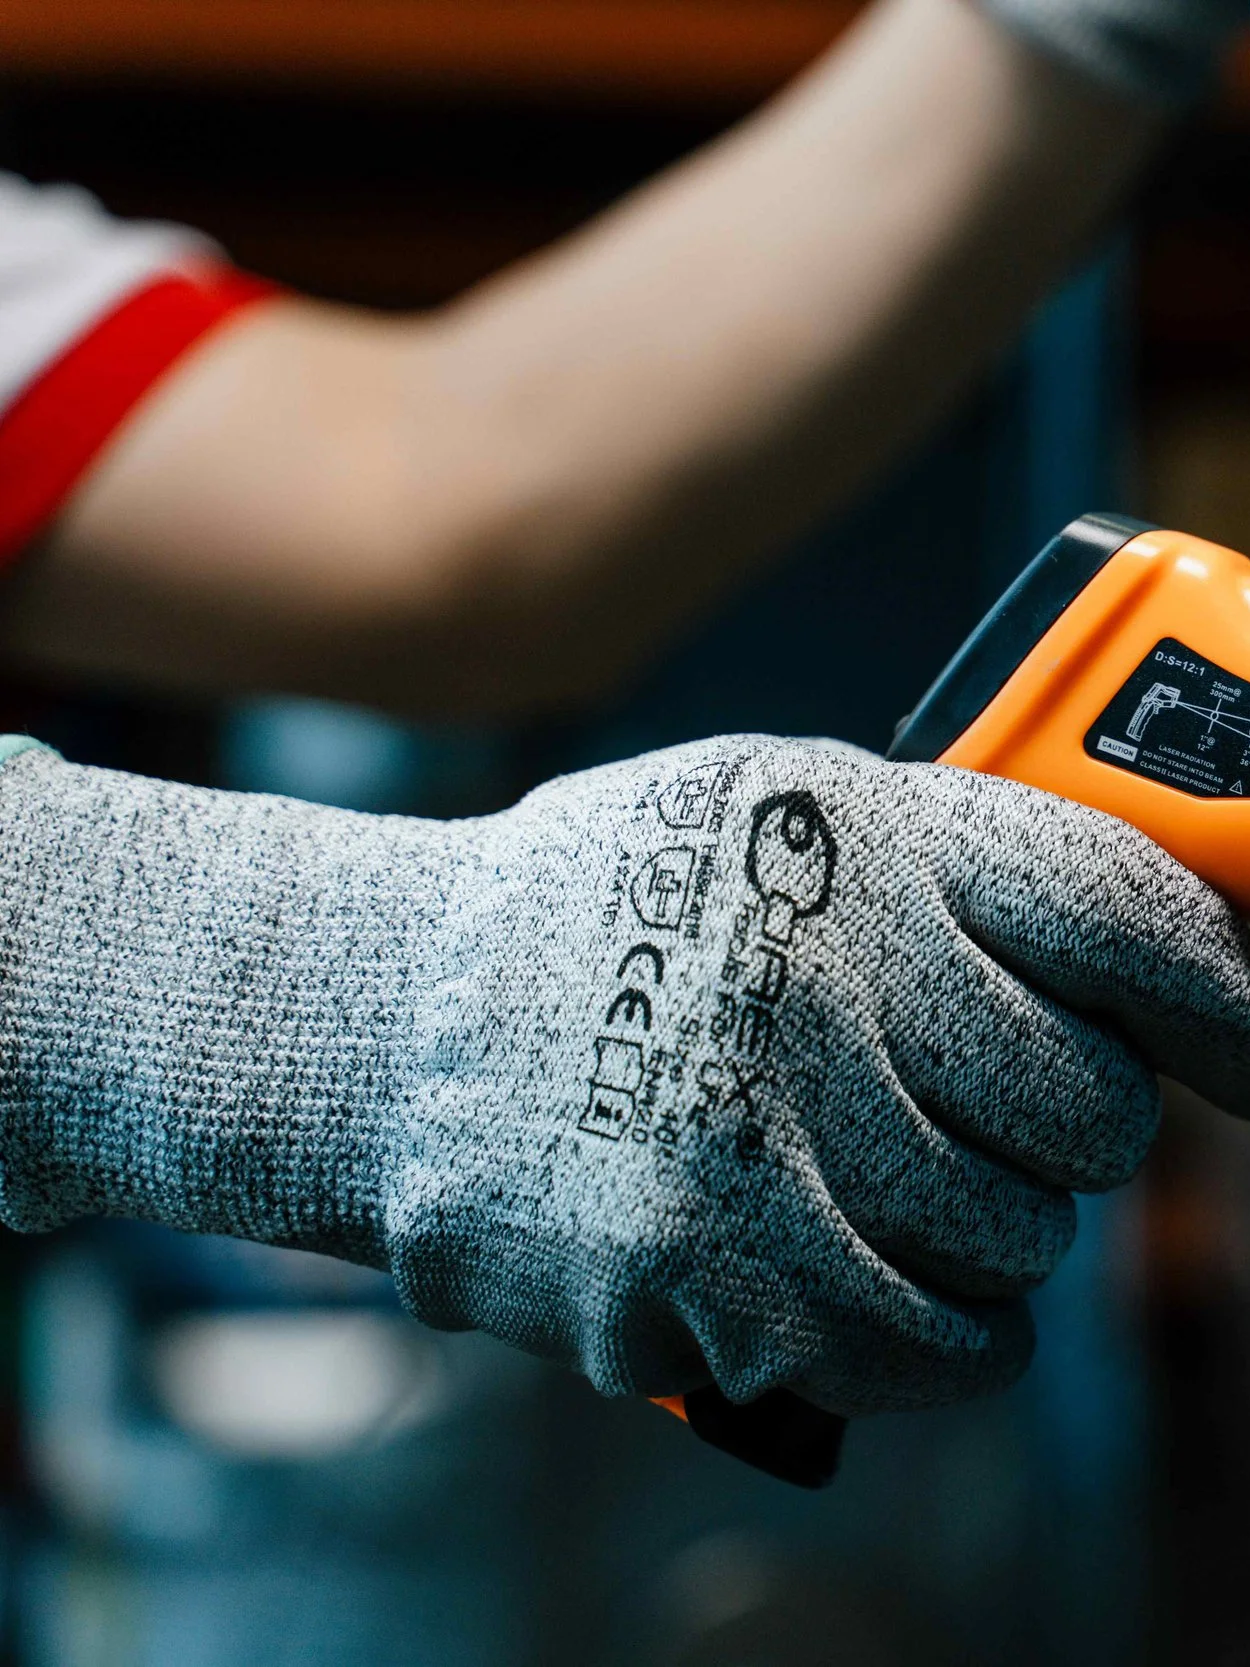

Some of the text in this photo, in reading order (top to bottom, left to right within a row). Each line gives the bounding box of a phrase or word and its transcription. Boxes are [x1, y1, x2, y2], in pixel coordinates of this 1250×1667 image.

[1155, 651, 1205, 676] D:S=12:1
[1210, 689, 1235, 703] 300mm
[1213, 681, 1241, 697] 25mm@
[1102, 741, 1134, 756] CAUTION
[1159, 745, 1215, 769] LASER RADIATION
[1140, 761, 1160, 773] CLASS
[1168, 770, 1188, 782] LASER
[1189, 779, 1220, 794] PRODUCT
[1153, 754, 1166, 762] NOT
[1168, 760, 1188, 770] STARE
[1189, 767, 1204, 776] INTO
[1205, 773, 1223, 783] BEAM
